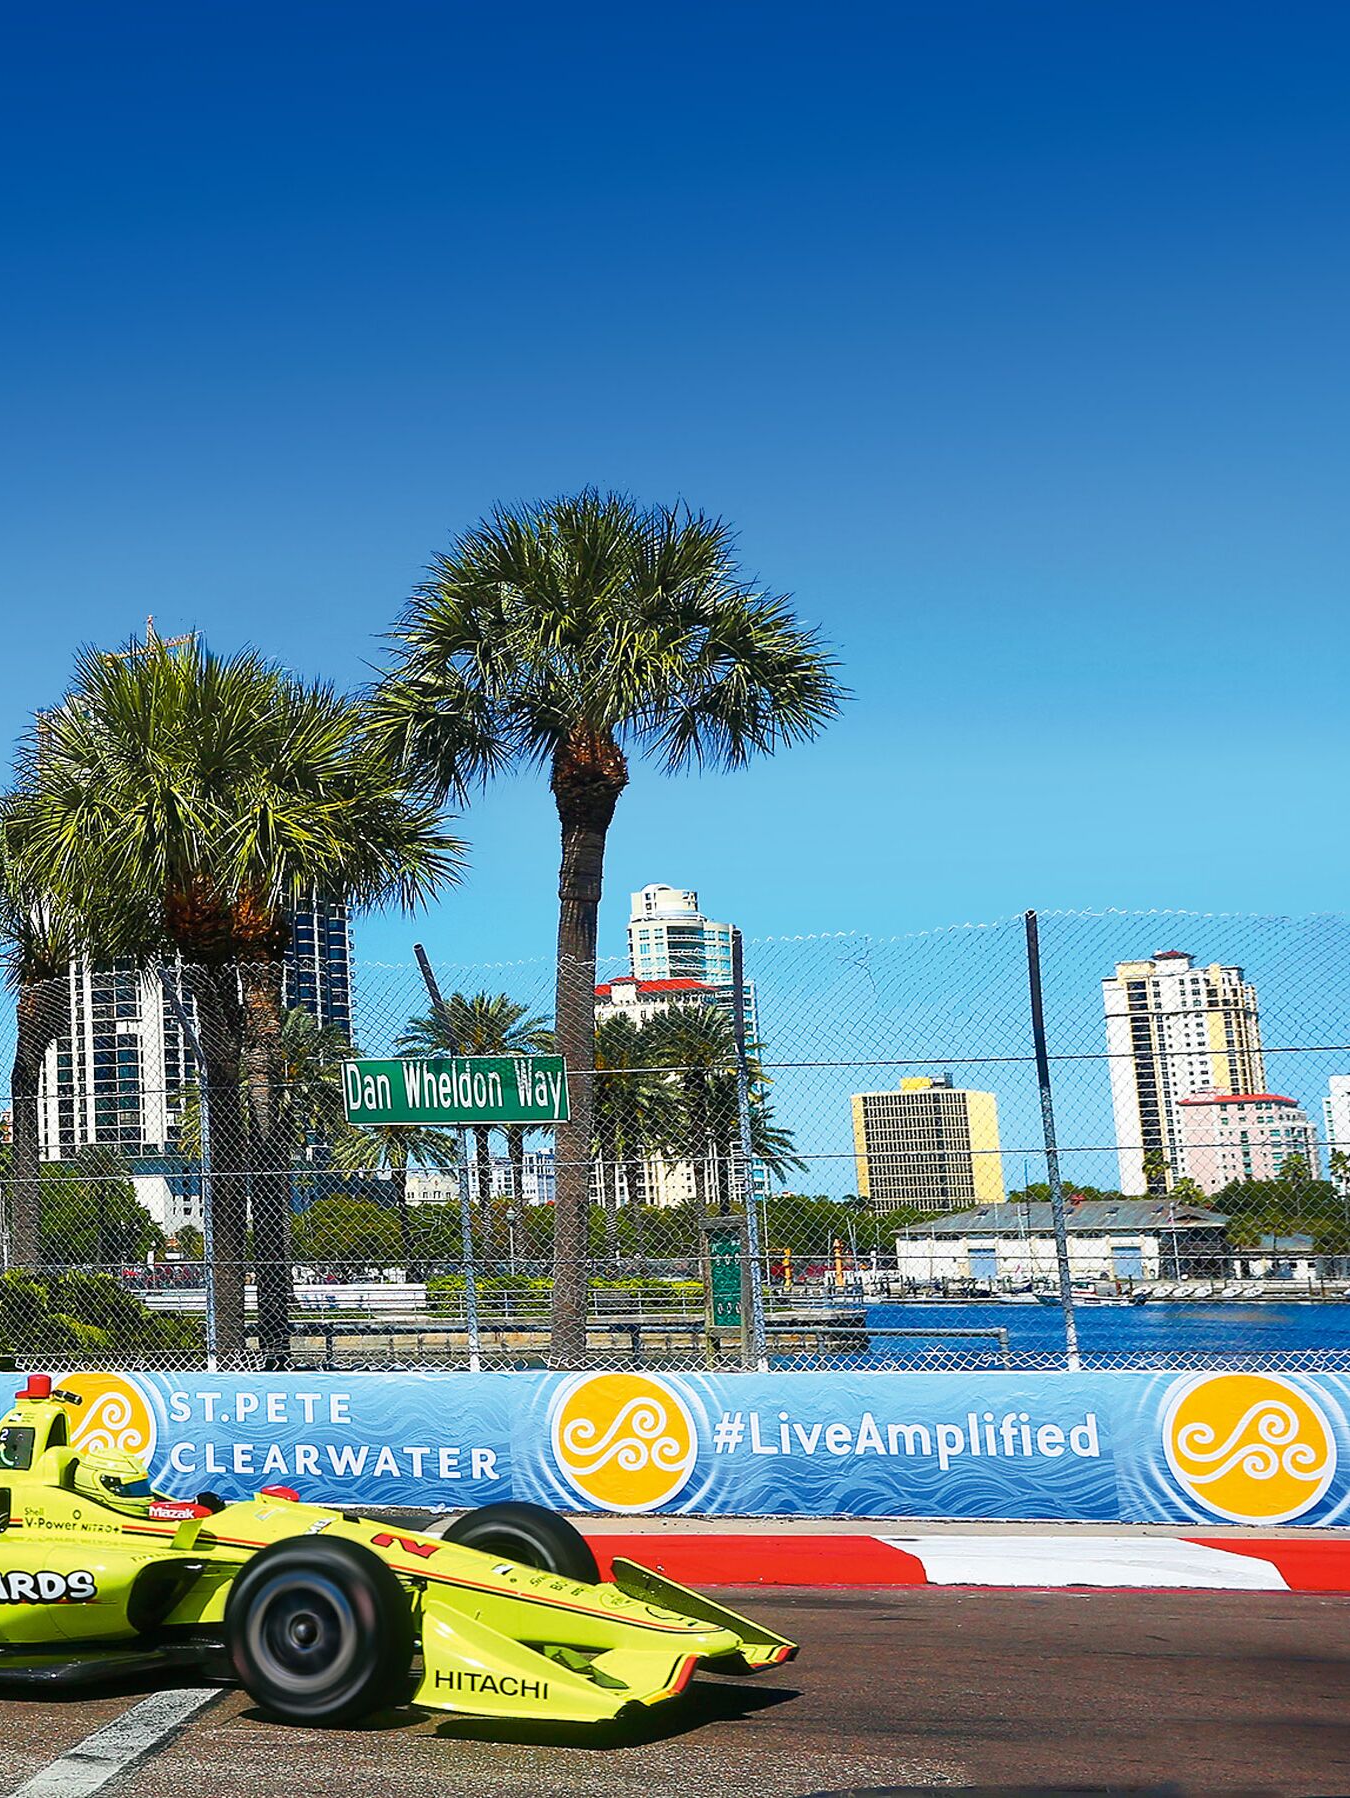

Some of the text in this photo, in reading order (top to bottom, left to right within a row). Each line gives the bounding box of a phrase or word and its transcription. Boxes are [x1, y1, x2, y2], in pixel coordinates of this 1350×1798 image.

[346, 1058, 562, 1120] Dan Wheldon Way
[168, 1391, 352, 1424] ST.PETE
[0, 1428, 10, 1441] 2
[712, 1410, 1101, 1471] #LiveAmplified
[169, 1441, 500, 1480] CLEARWATER
[24, 1517, 77, 1531] V-Power
[148, 1504, 195, 1519] Mazak
[435, 1669, 548, 1700] HITACHI
